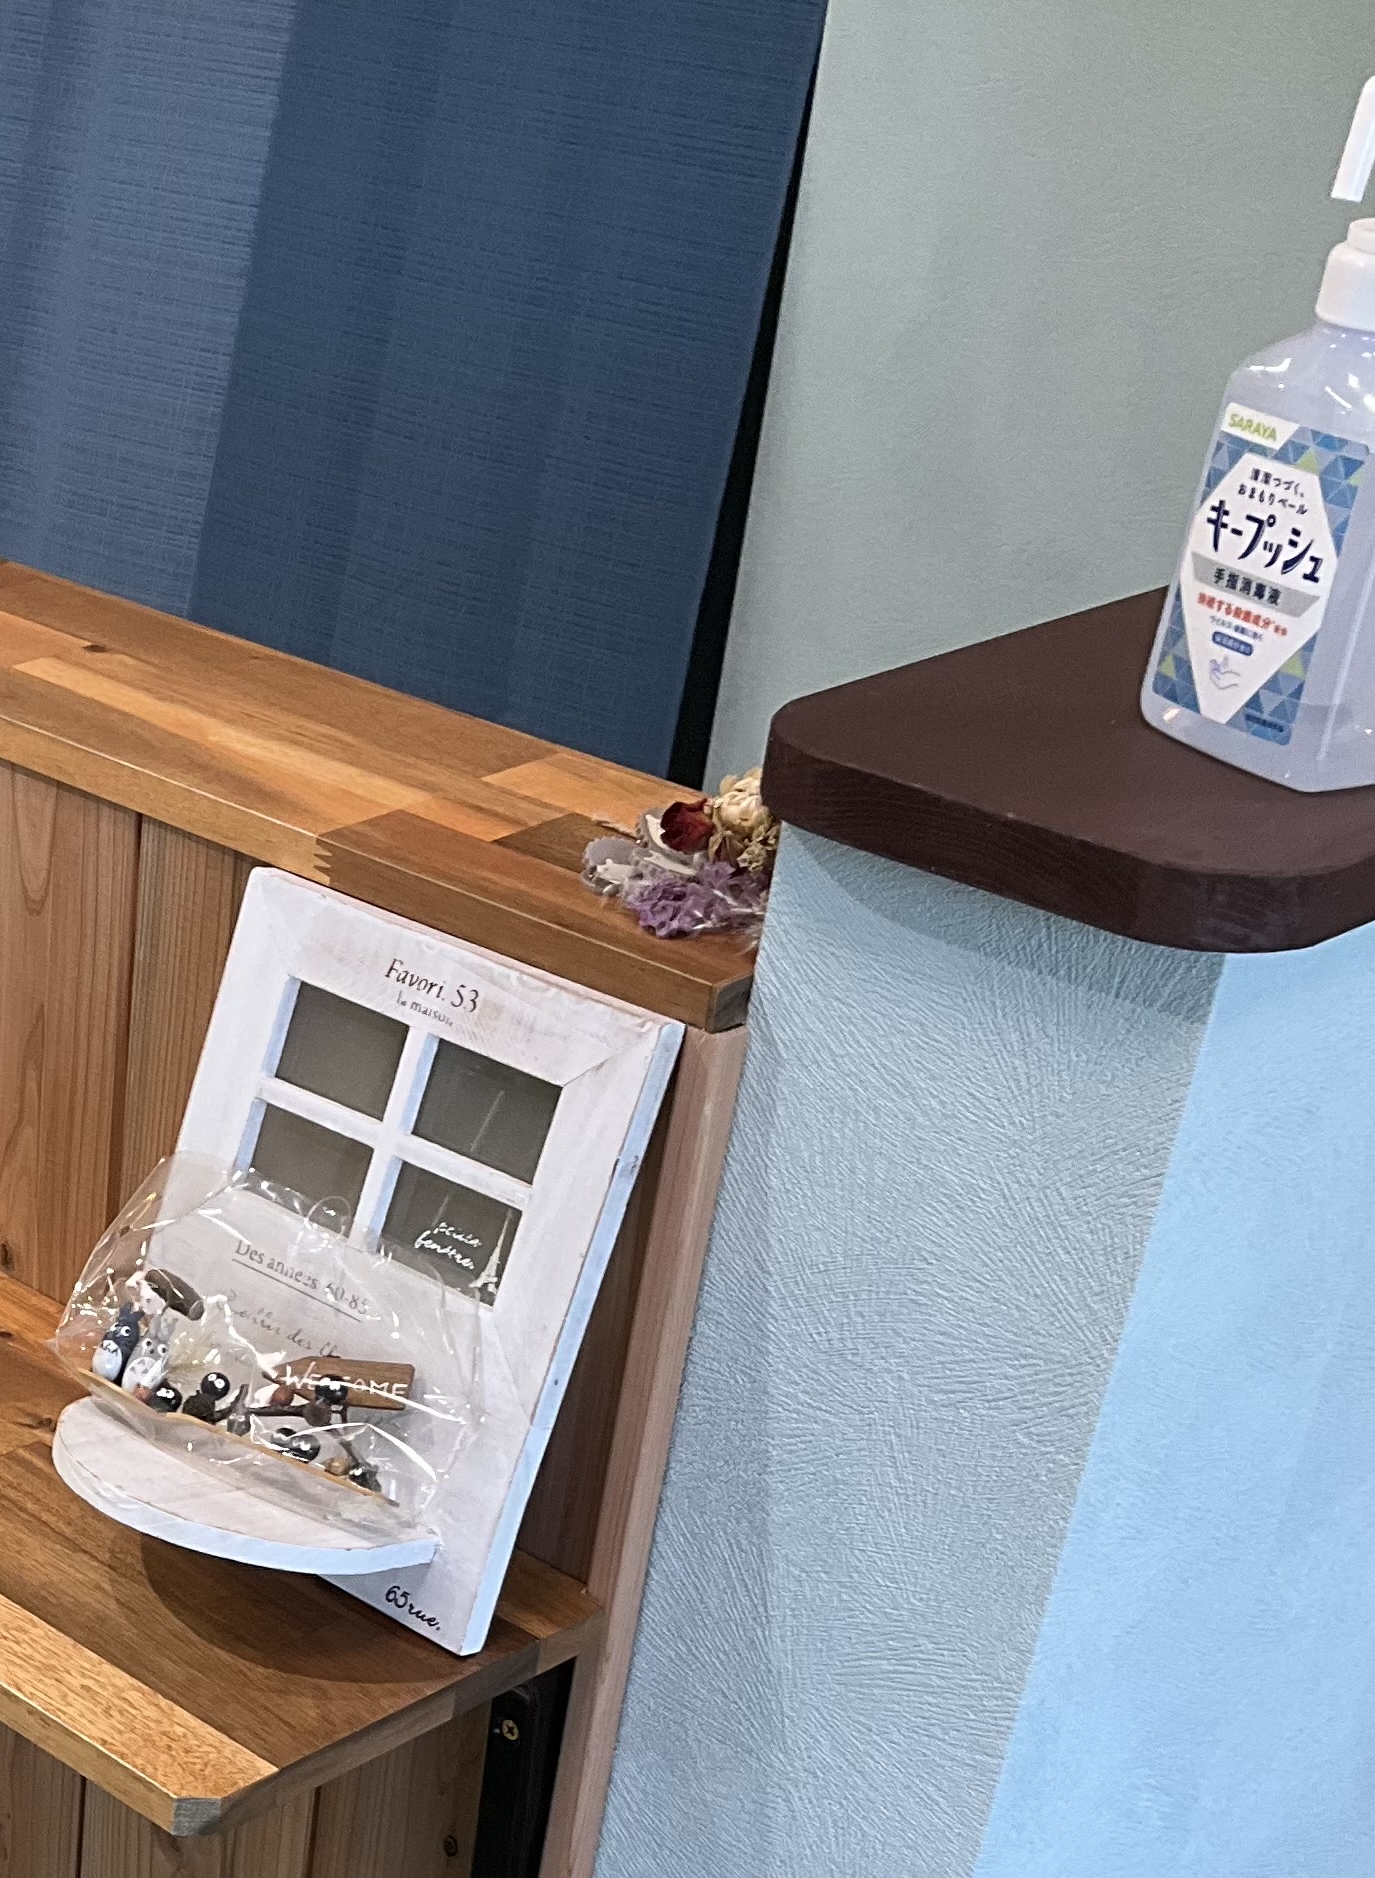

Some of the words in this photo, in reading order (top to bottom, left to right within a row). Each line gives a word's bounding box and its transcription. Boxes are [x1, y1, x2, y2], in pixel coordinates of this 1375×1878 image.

[1228, 414, 1277, 441] SARAYA
[1206, 500, 1323, 583] キープッシュ
[1213, 567, 1281, 606] 手指消毒液
[450, 984, 479, 1013] 53
[235, 1240, 265, 1264] Des
[284, 1361, 409, 1397] WEOME
